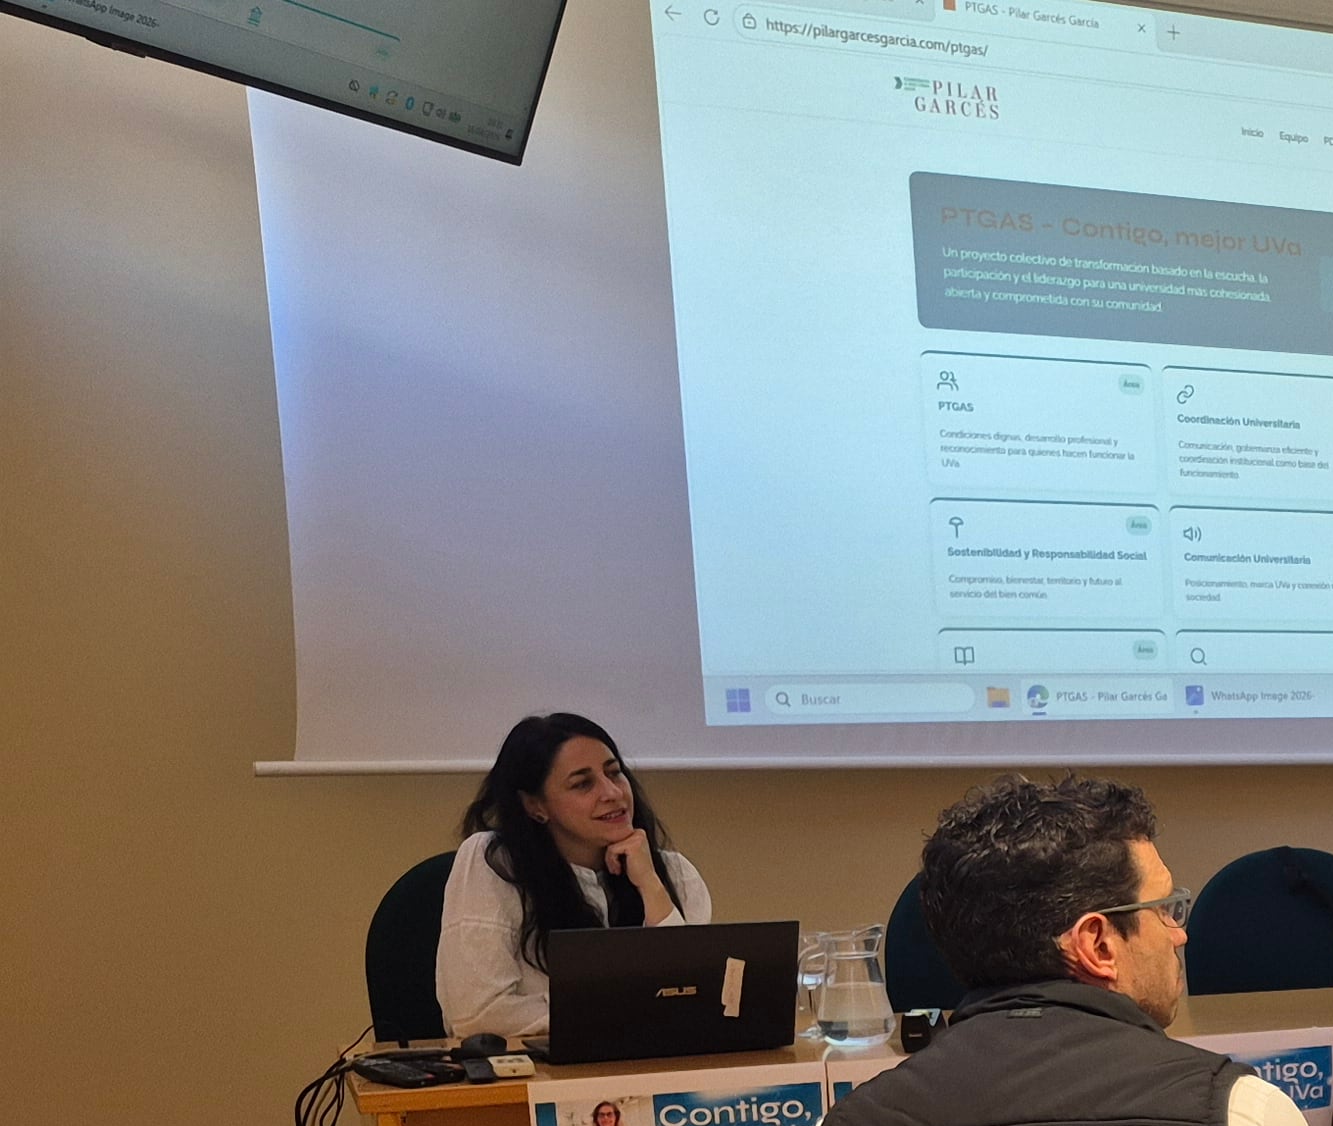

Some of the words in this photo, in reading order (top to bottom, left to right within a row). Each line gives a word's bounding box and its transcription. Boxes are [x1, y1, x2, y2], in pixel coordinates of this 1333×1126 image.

[109, 6, 135, 22] Image
[965, 1, 999, 15] PTGAS
[1008, 7, 1030, 20] Pilar
[766, 17, 989, 58] https://pilargarcesgarcia.com/ptgas/
[932, 80, 998, 102] PILAR
[914, 96, 1000, 120] GARCÉS
[1241, 127, 1265, 138] Inicio
[1279, 131, 1309, 144] Equipo
[941, 207, 1034, 232] PTGAS
[1062, 218, 1169, 248] Contigo,
[1175, 230, 1246, 254] mejor
[1252, 234, 1302, 257] UVa
[961, 251, 1008, 262] proyecto
[1009, 253, 1057, 266] colectivo
[1151, 264, 1188, 277] basado
[1033, 272, 1081, 288] liderazgo
[1083, 280, 1105, 289] para
[1108, 282, 1127, 290] una
[1129, 281, 1185, 295] universidad
[945, 287, 982, 299] abierta
[992, 293, 1069, 306] comprometida
[1070, 299, 1090, 307] con
[938, 401, 974, 413] PTGAS
[1242, 417, 1301, 430] Universitaria
[947, 546, 1022, 558] Sostenibilidad
[1023, 550, 1030, 560] y
[1032, 549, 1116, 561] Responsabilidad
[1117, 550, 1148, 561] Social
[1253, 554, 1311, 565] Universitaria
[801, 692, 841, 706] Buscar
[1056, 691, 1088, 702] PTGAS
[1097, 691, 1118, 702] Pilar
[1211, 690, 1258, 703] WhatsApp
[1260, 691, 1281, 703] Image
